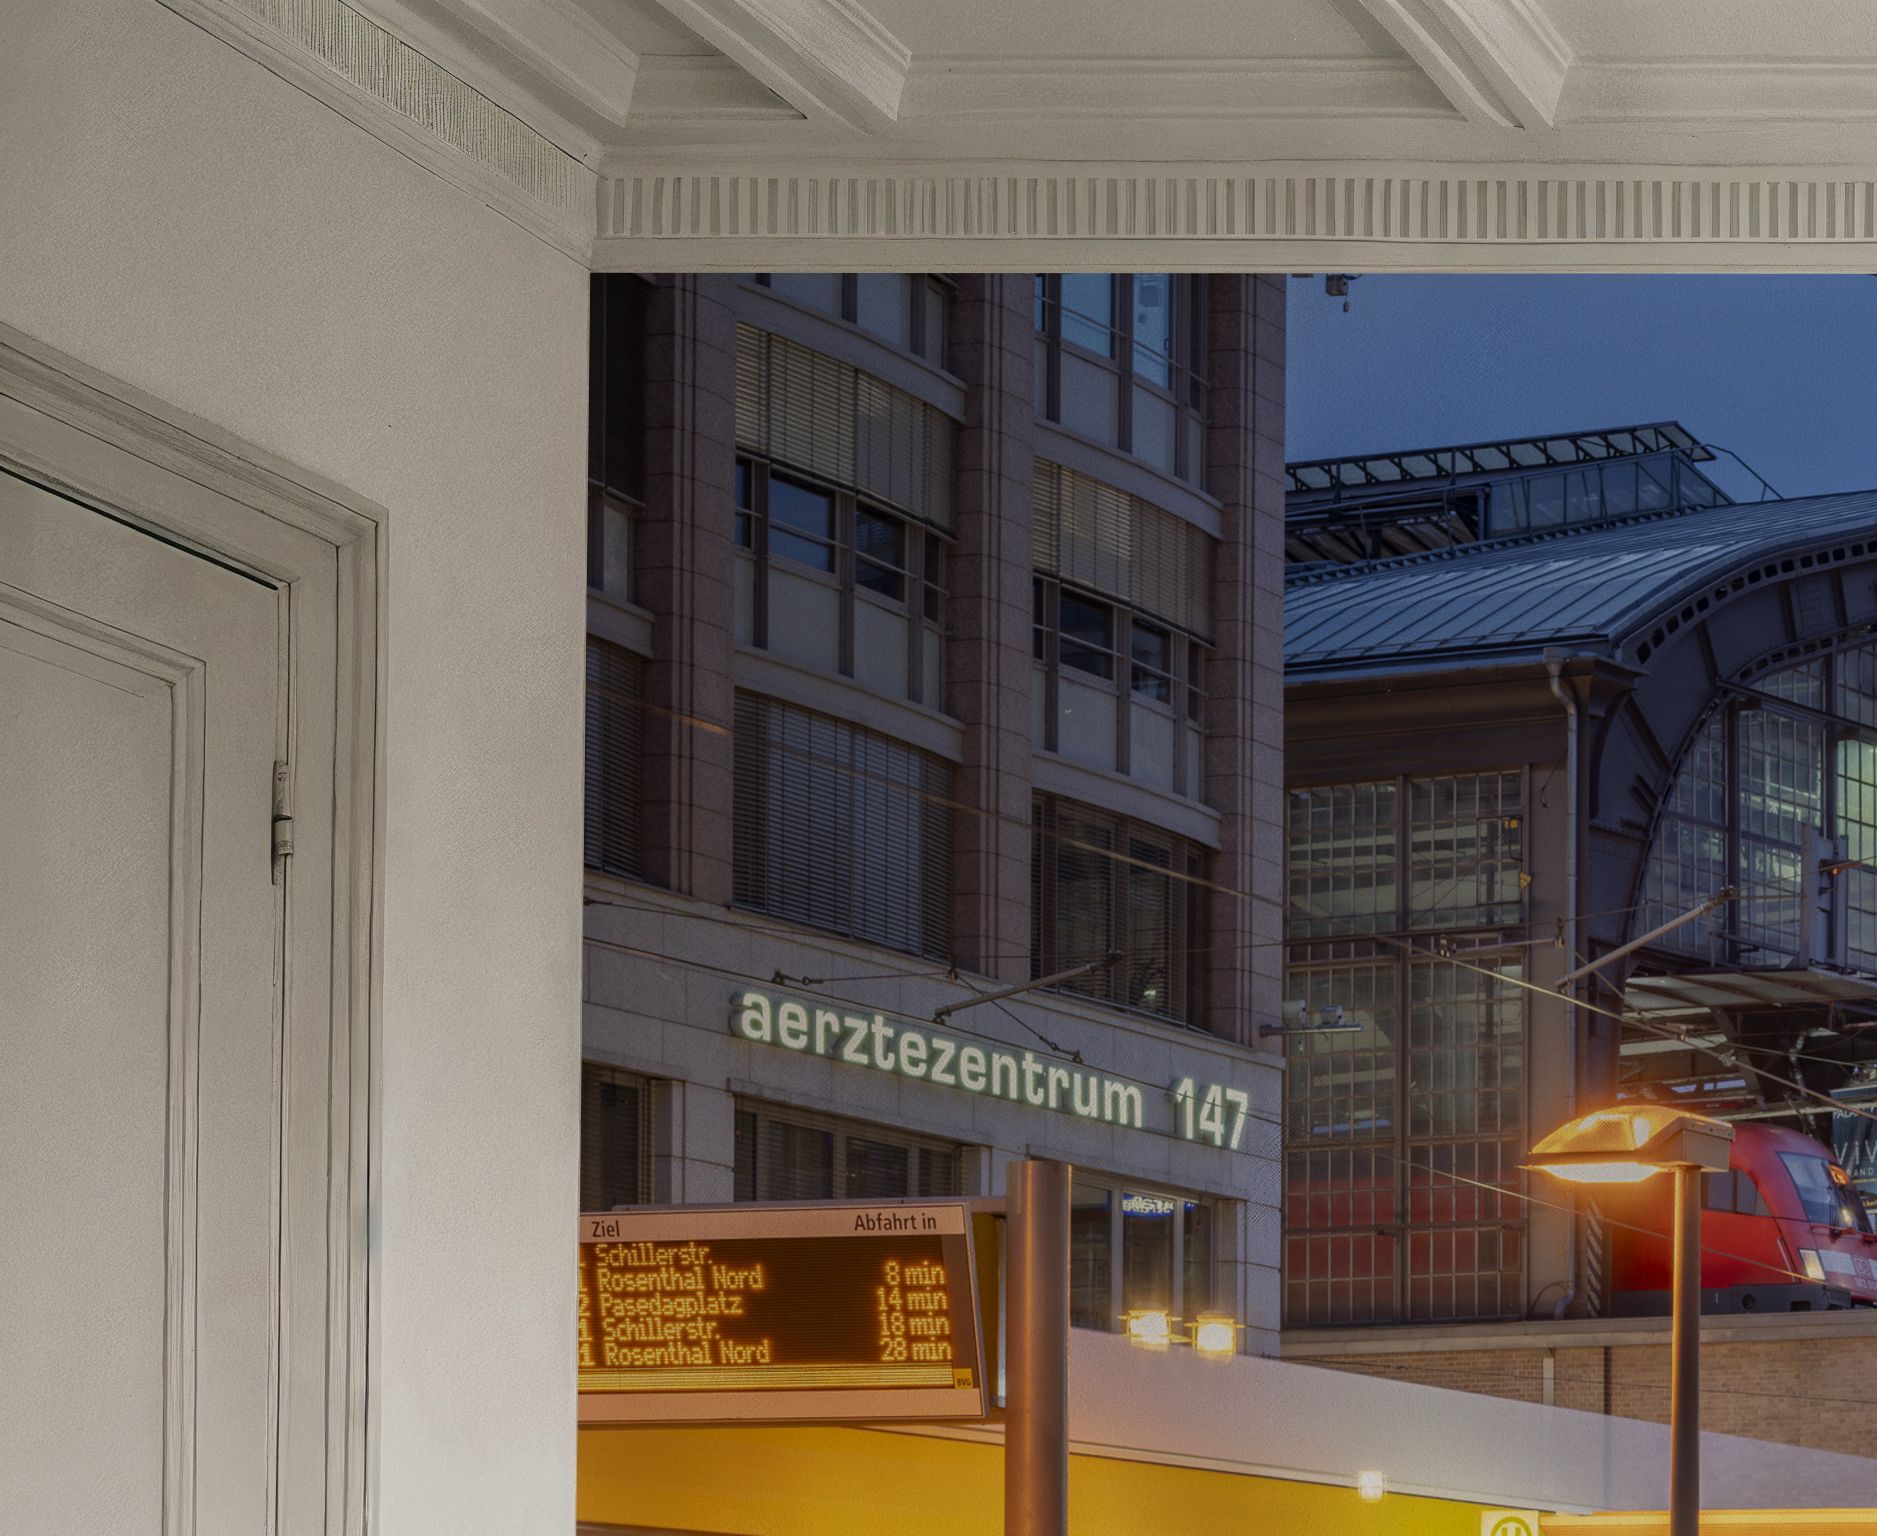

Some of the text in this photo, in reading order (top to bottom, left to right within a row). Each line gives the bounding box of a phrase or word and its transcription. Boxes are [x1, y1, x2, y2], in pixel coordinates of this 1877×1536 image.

[739, 991, 1250, 1151] aerztezentrum 147
[591, 1212, 937, 1238] Ziel Abfahrt in
[594, 1242, 713, 1266] Schillerstr.
[598, 1266, 705, 1291] Rosenthal
[711, 1264, 764, 1289] Nord
[885, 1261, 900, 1285] 8
[904, 1261, 946, 1285] min
[600, 1291, 744, 1318] Pasedagplatz
[877, 1286, 903, 1311] 14
[906, 1286, 948, 1311] min
[602, 1317, 721, 1342] Schillerstr.
[878, 1312, 905, 1336] 18
[909, 1312, 950, 1336] min
[605, 1340, 713, 1367] Rosenthal
[719, 1338, 770, 1364] Nord
[880, 1337, 908, 1362] 28
[911, 1337, 953, 1361] min
